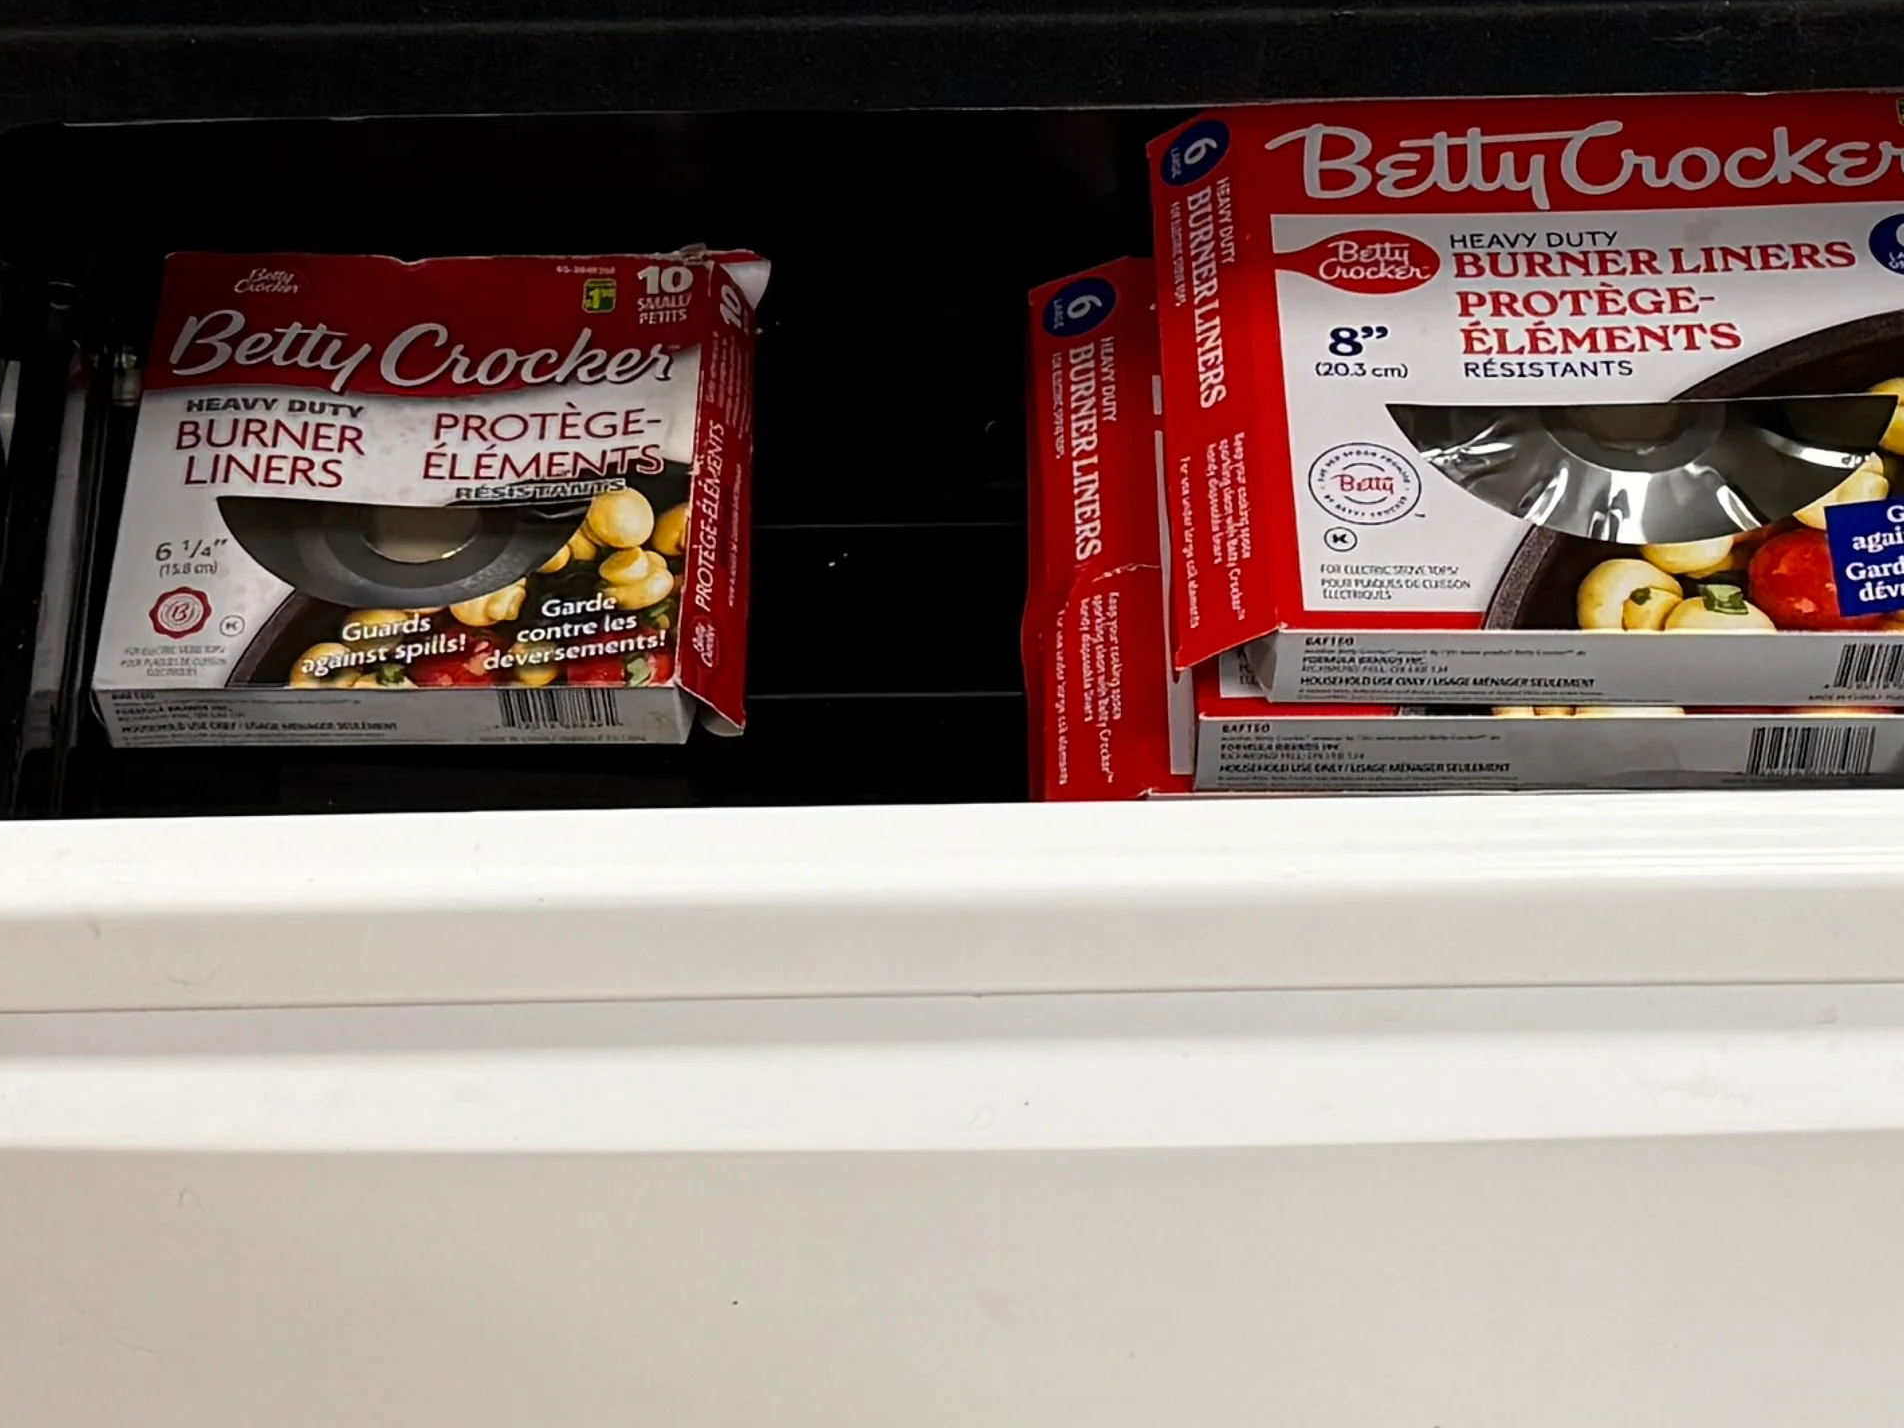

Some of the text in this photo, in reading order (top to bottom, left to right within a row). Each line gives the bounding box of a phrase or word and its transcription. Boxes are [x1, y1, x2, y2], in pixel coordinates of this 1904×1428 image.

[1183, 136, 1219, 165] 6
[1264, 122, 1552, 210] Betty
[1216, 176, 1236, 263] HEAVY DUTY
[1327, 240, 1410, 267] Betty
[1449, 230, 1619, 250] HEAVY DUTY
[1453, 241, 1856, 280] BURNER LINERS
[636, 265, 694, 295] 10
[719, 284, 743, 328] 10
[1066, 294, 1103, 320] 6
[1187, 185, 1227, 409] BURNER LINERS
[1456, 281, 1716, 319] PROTÈGE-
[638, 309, 688, 324] PETITS
[169, 308, 373, 393] Betty
[380, 322, 673, 387] Crocker
[1461, 321, 1742, 356] ÉLÉMENTS
[1100, 335, 1117, 422] HEAVY DUTY
[1315, 362, 1409, 380] (20.3 cm)
[1463, 358, 1634, 379] RÉSISTANTS
[186, 396, 364, 418] HEAVY DUTY
[433, 401, 662, 443] PROTÈGE-
[175, 418, 366, 456] BURNER
[1069, 341, 1103, 562] BURNER LINERS
[183, 453, 343, 488] LINERS
[422, 442, 666, 481] ÉLÉMENTS
[454, 477, 627, 501] RÉSISTANTS
[1330, 473, 1396, 496] Betty
[154, 541, 172, 561] 6
[541, 591, 618, 617] Garde
[342, 613, 431, 642] Guards
[516, 613, 638, 643] contre les
[301, 633, 467, 677] against spills!
